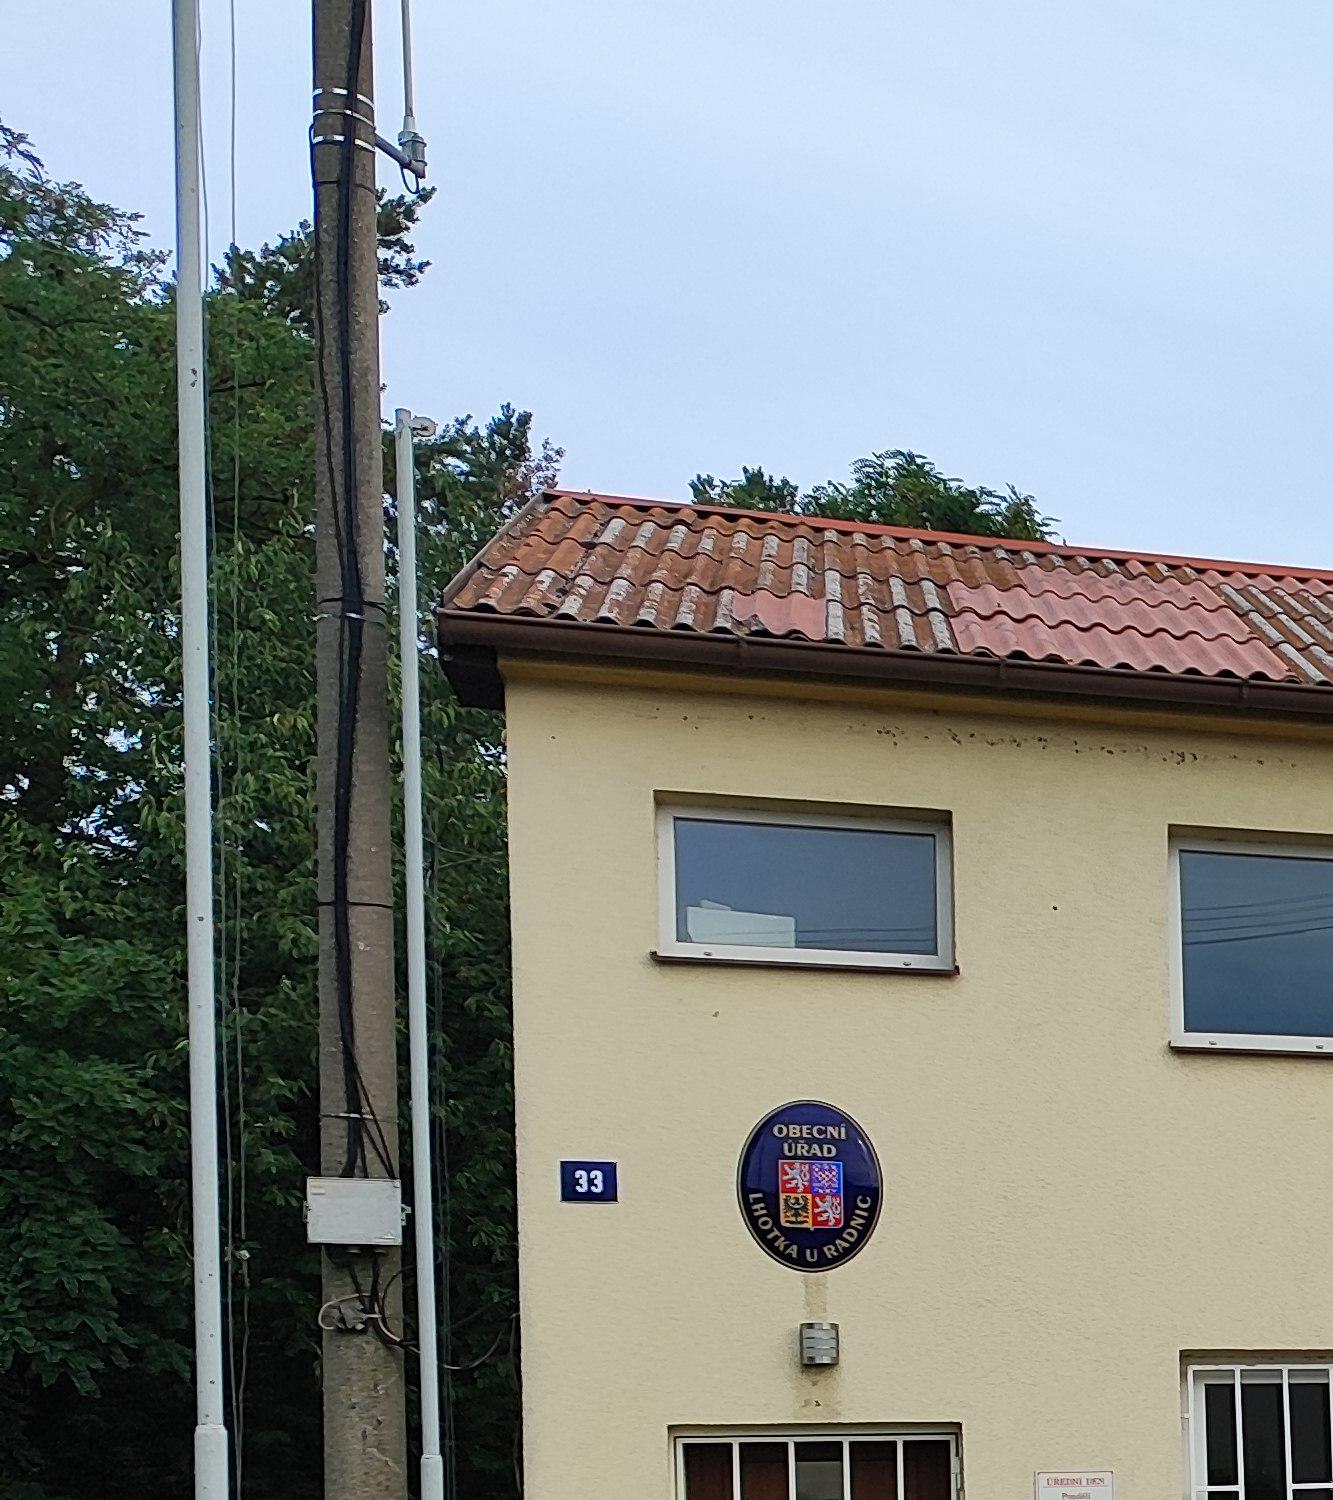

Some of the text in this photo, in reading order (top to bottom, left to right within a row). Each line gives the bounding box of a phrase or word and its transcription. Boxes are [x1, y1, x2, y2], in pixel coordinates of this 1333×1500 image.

[773, 1123, 847, 1140] OBECNÍ
[782, 1139, 837, 1157] ÚŘAD
[574, 1169, 604, 1193] 33
[748, 1193, 872, 1262] LHOTKA U RADNIC
